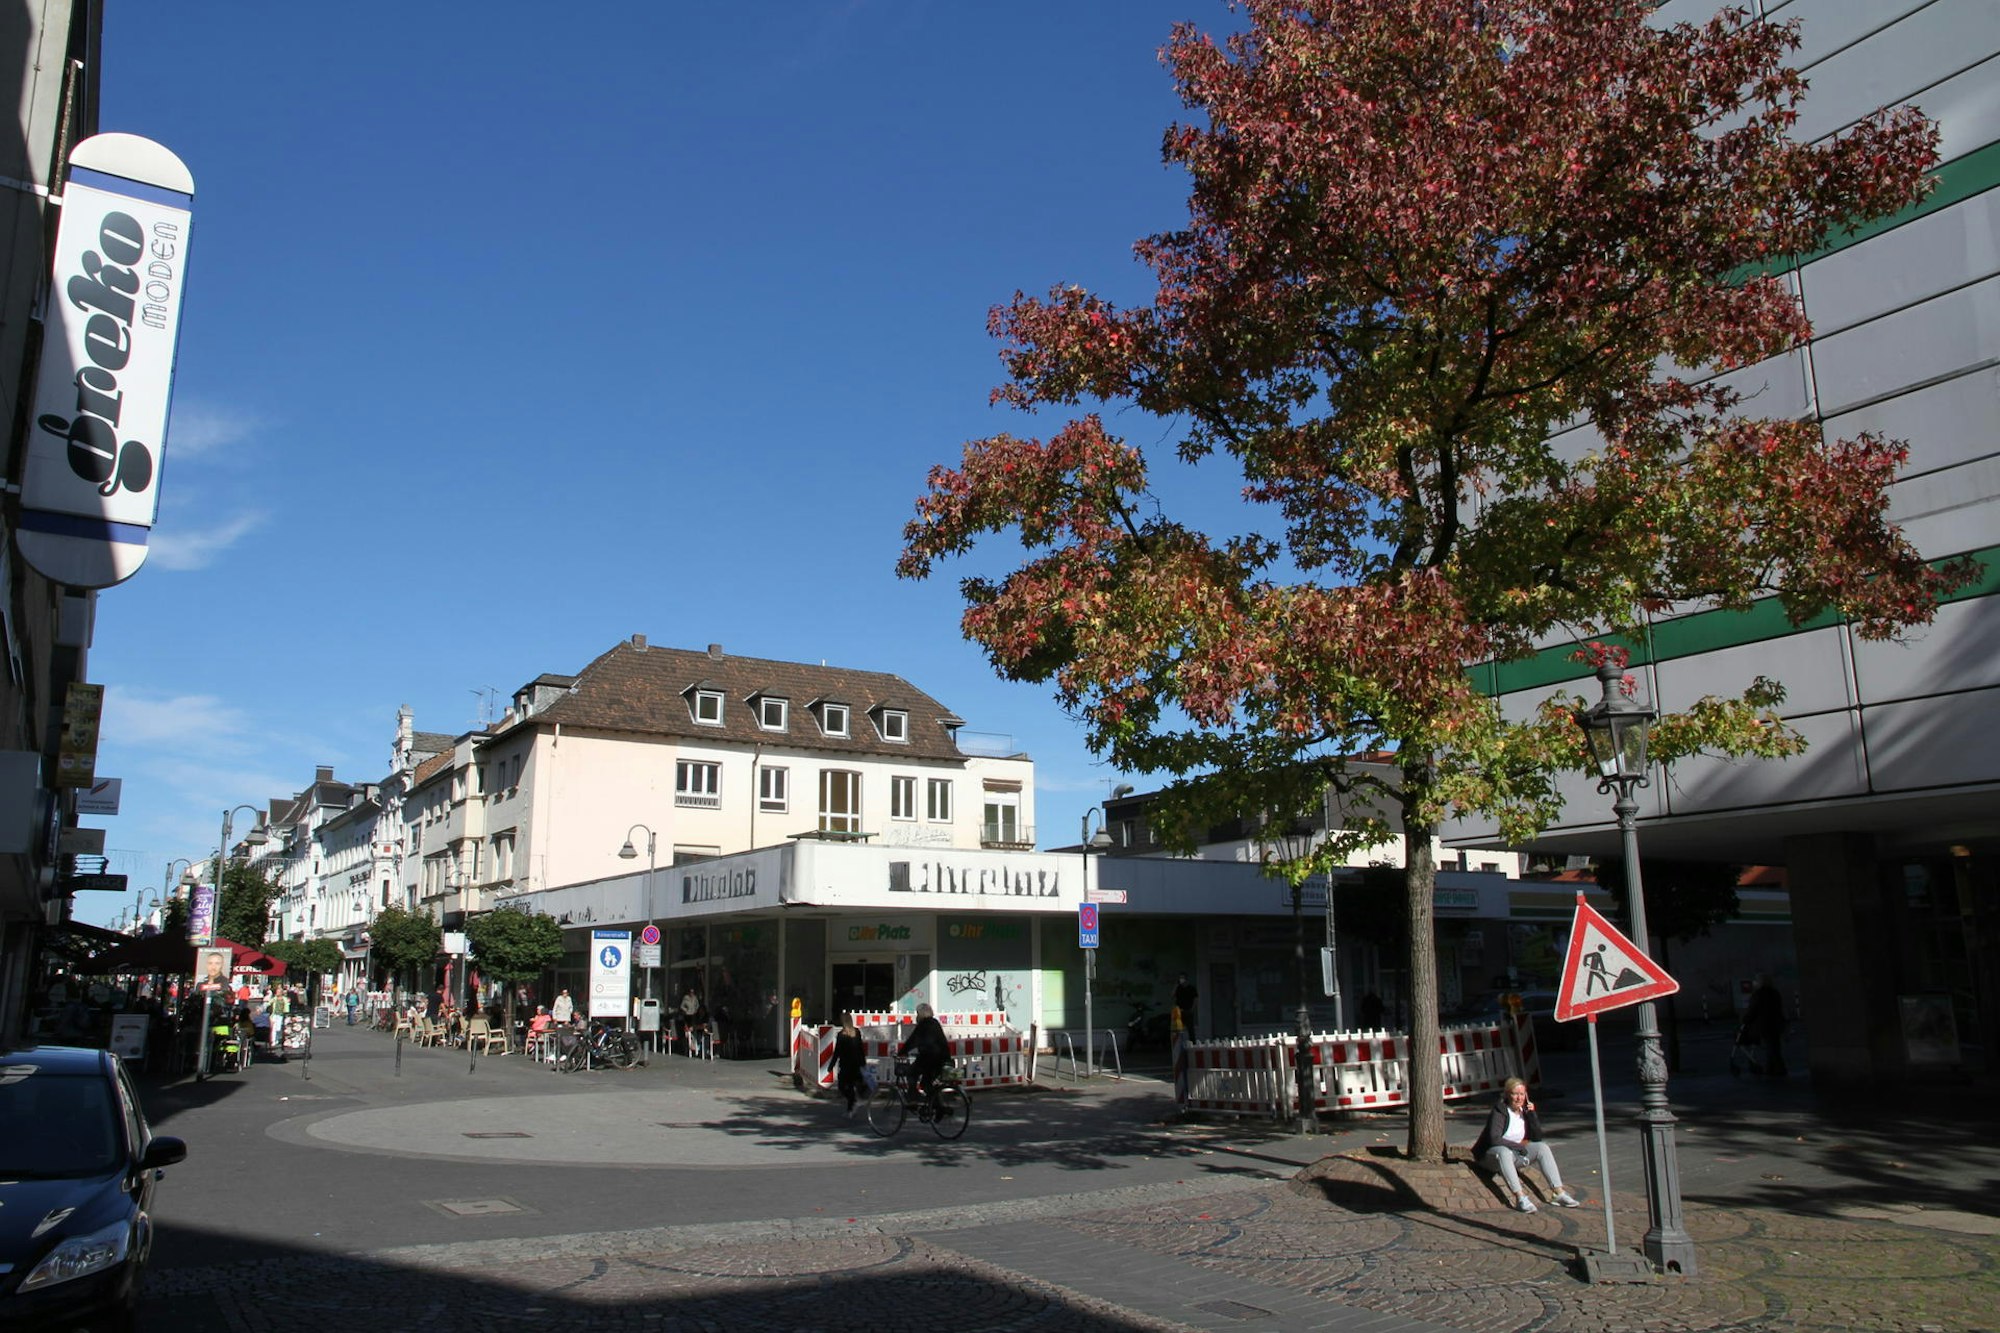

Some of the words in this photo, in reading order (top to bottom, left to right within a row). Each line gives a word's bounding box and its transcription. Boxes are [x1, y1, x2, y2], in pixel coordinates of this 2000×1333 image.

[38, 210, 153, 497] greko
[877, 923, 911, 940] Platz
[1081, 933, 1097, 944] TAXI
